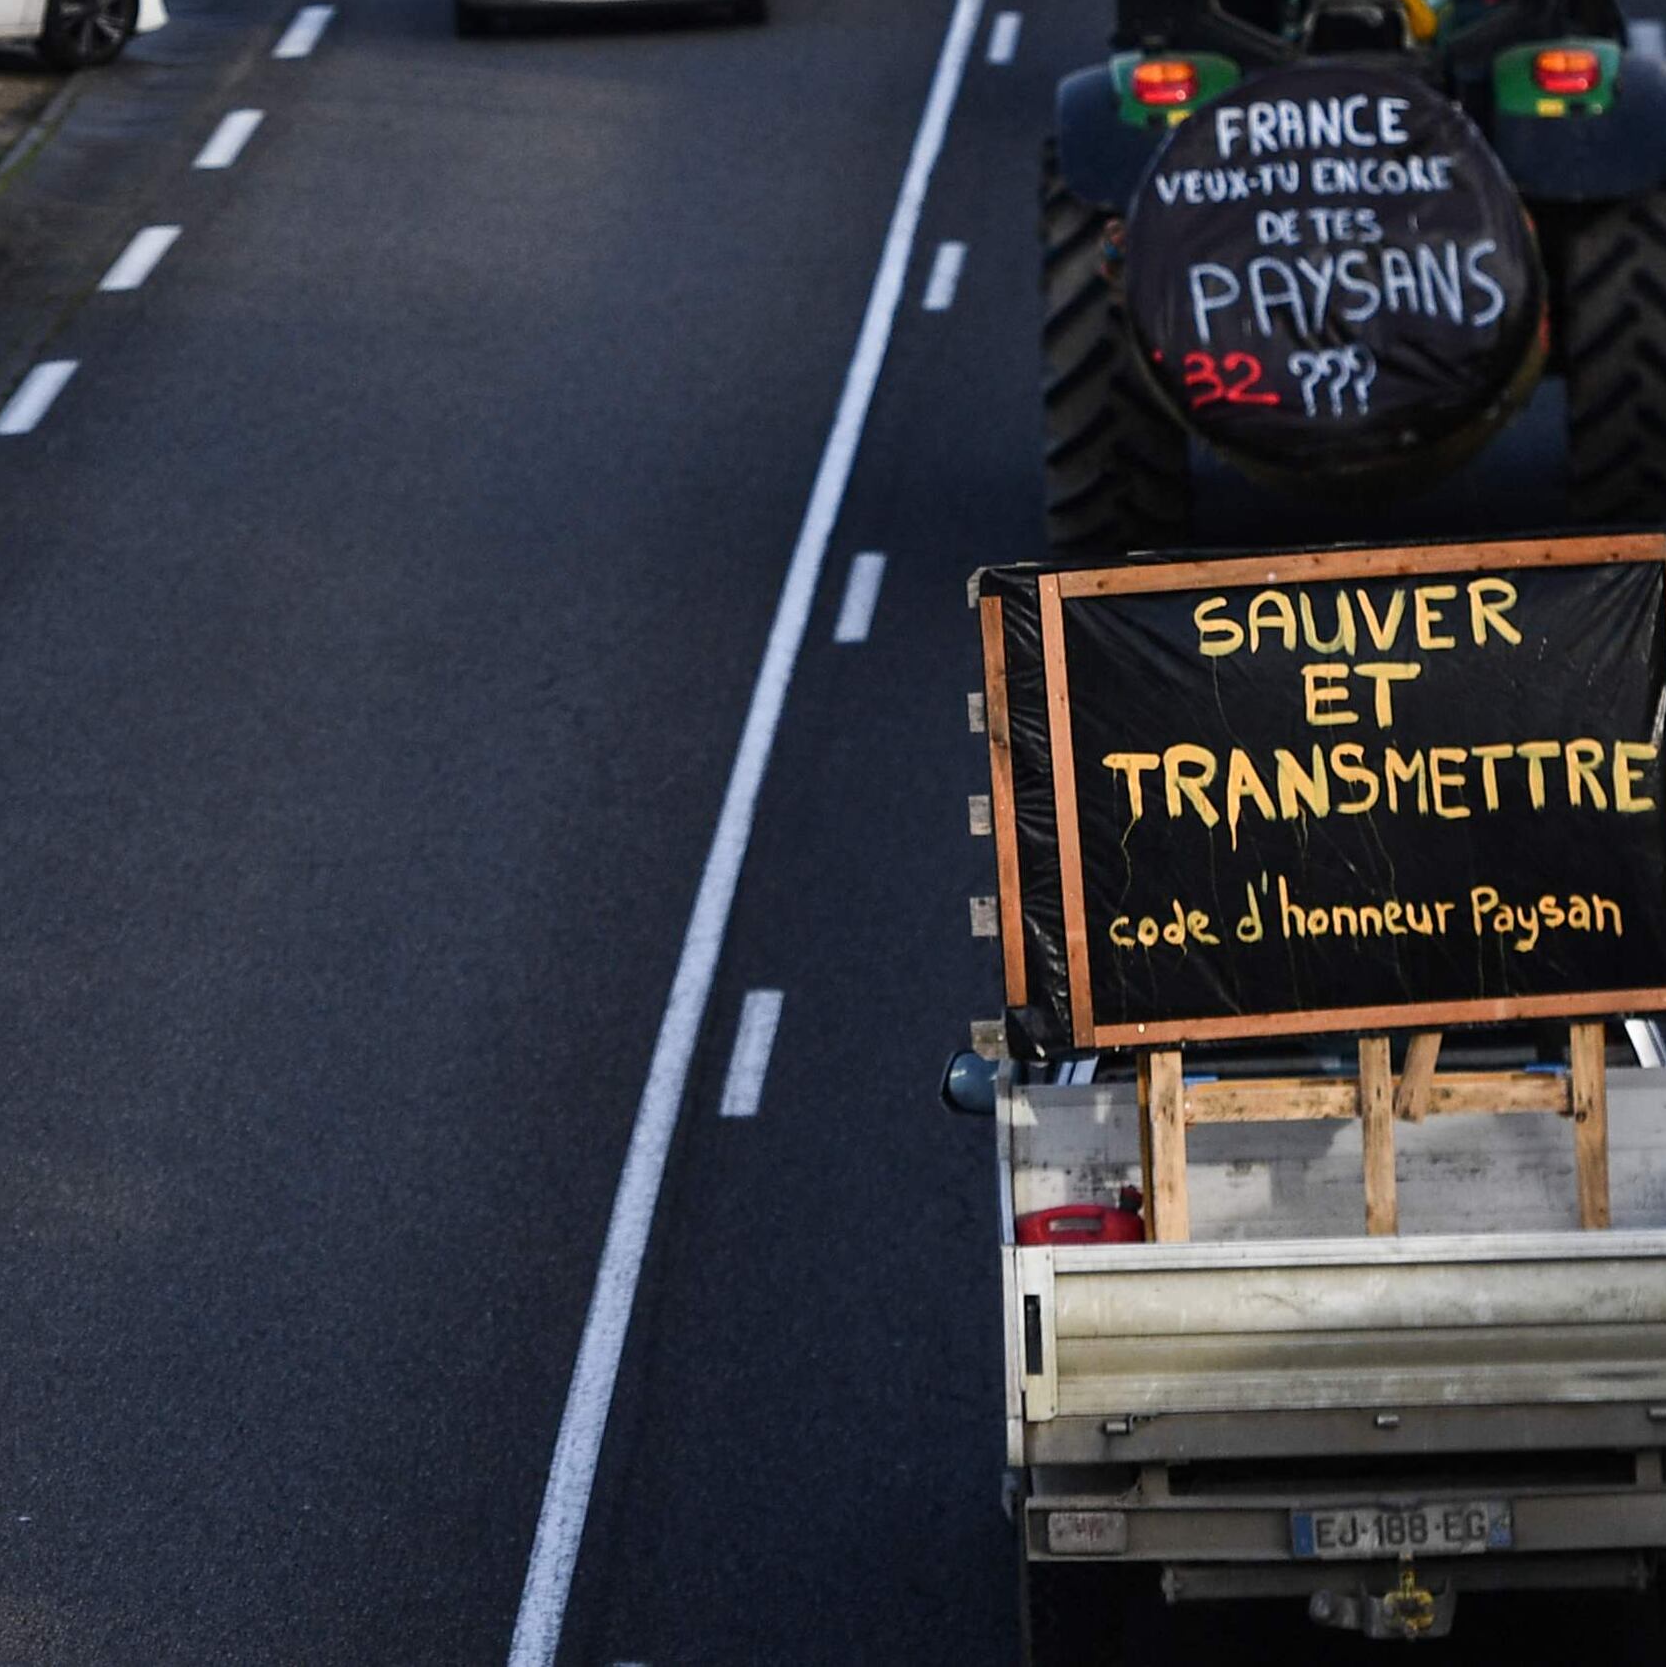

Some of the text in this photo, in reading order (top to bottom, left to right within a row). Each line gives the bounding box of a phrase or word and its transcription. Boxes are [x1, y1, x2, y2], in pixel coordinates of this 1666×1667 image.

[1214, 94, 1411, 159] FRANCE
[1154, 155, 1459, 205] VEUX-TU ENCORE
[1256, 207, 1384, 245] DE TES
[1188, 239, 1506, 345] PAYSANS
[1183, 351, 1281, 410] 32
[1193, 578, 1522, 656] SAUVER
[1301, 662, 1420, 728] ET
[1103, 738, 1658, 832] TRANSMETTRE
[1109, 873, 1623, 952] code d'honneur Paysan
